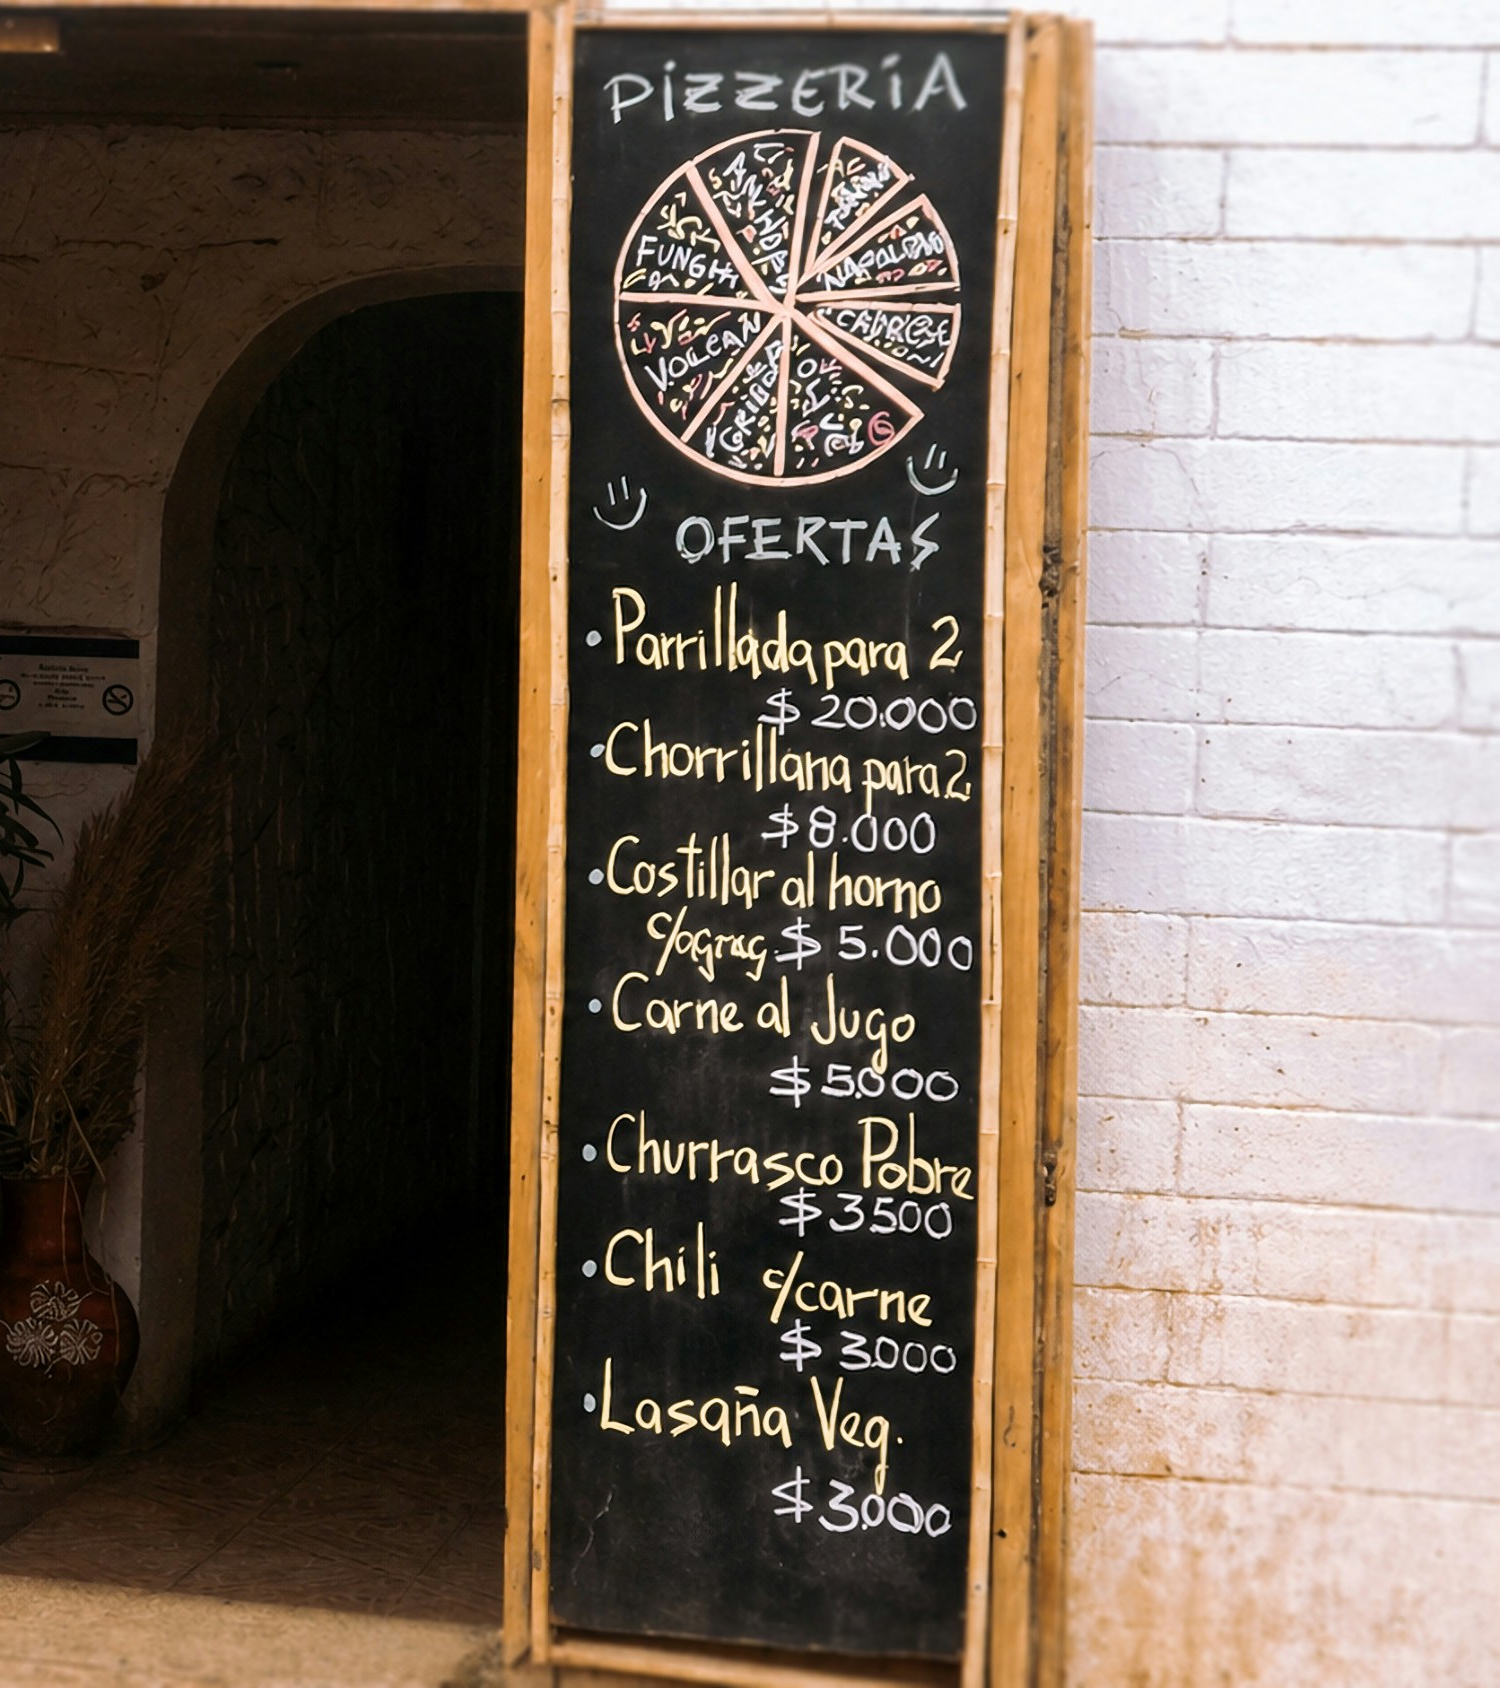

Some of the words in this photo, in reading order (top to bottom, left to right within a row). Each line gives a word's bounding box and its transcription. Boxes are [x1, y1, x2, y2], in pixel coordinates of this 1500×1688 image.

[676, 511, 940, 571] OFERTAS
[612, 581, 818, 686] Parrillada
[824, 636, 910, 691] para
[929, 615, 963, 671] 2
[604, 718, 851, 792] Chorrillana
[861, 755, 940, 816] para
[943, 749, 972, 802] 2
[606, 832, 775, 910] Costillar
[781, 850, 815, 908] al
[828, 851, 942, 919] horno
[612, 972, 744, 1034] Carne
[756, 975, 790, 1037] al
[810, 972, 916, 1075] Jugo
[606, 1109, 844, 1191] Churrasco
[858, 1112, 974, 1200] Pobre
[604, 1221, 720, 1300] Chili
[600, 1357, 793, 1447] Lasaña
[811, 1376, 904, 1496] Veg.
